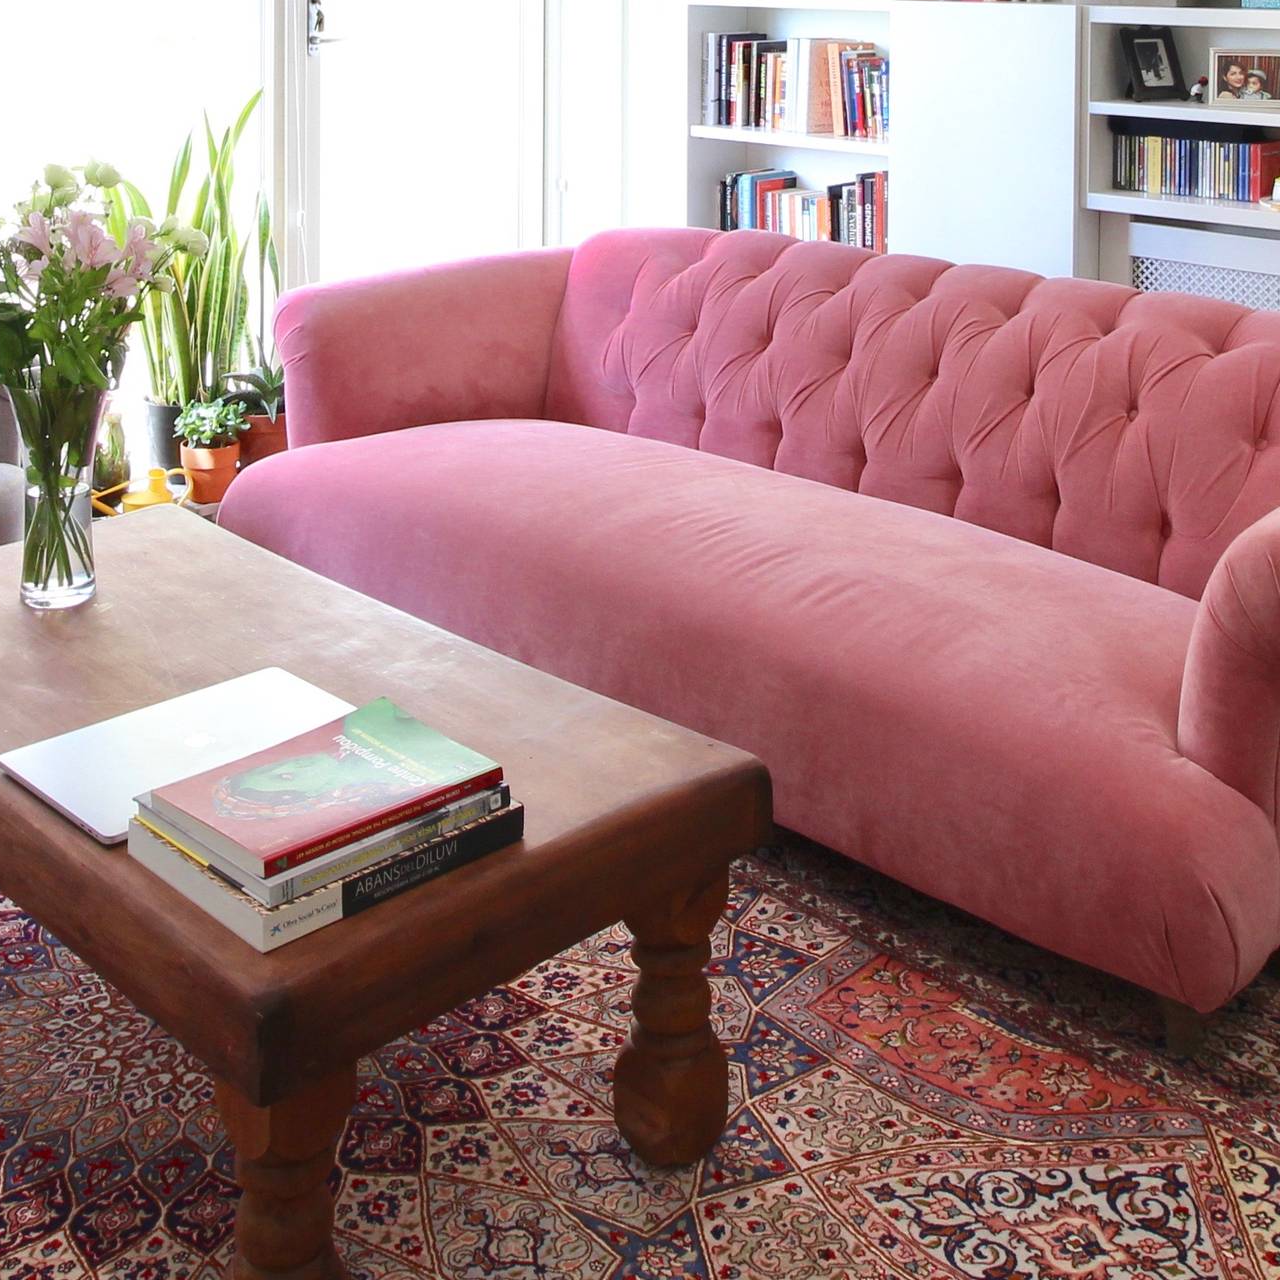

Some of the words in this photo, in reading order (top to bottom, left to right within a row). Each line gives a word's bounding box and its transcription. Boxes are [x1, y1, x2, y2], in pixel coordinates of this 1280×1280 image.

[864, 203, 872, 246] GENOMES
[332, 734, 389, 769] Pompidou
[390, 764, 426, 787] Centre
[355, 863, 401, 897] ABANS
[416, 841, 458, 871] DILUVI
